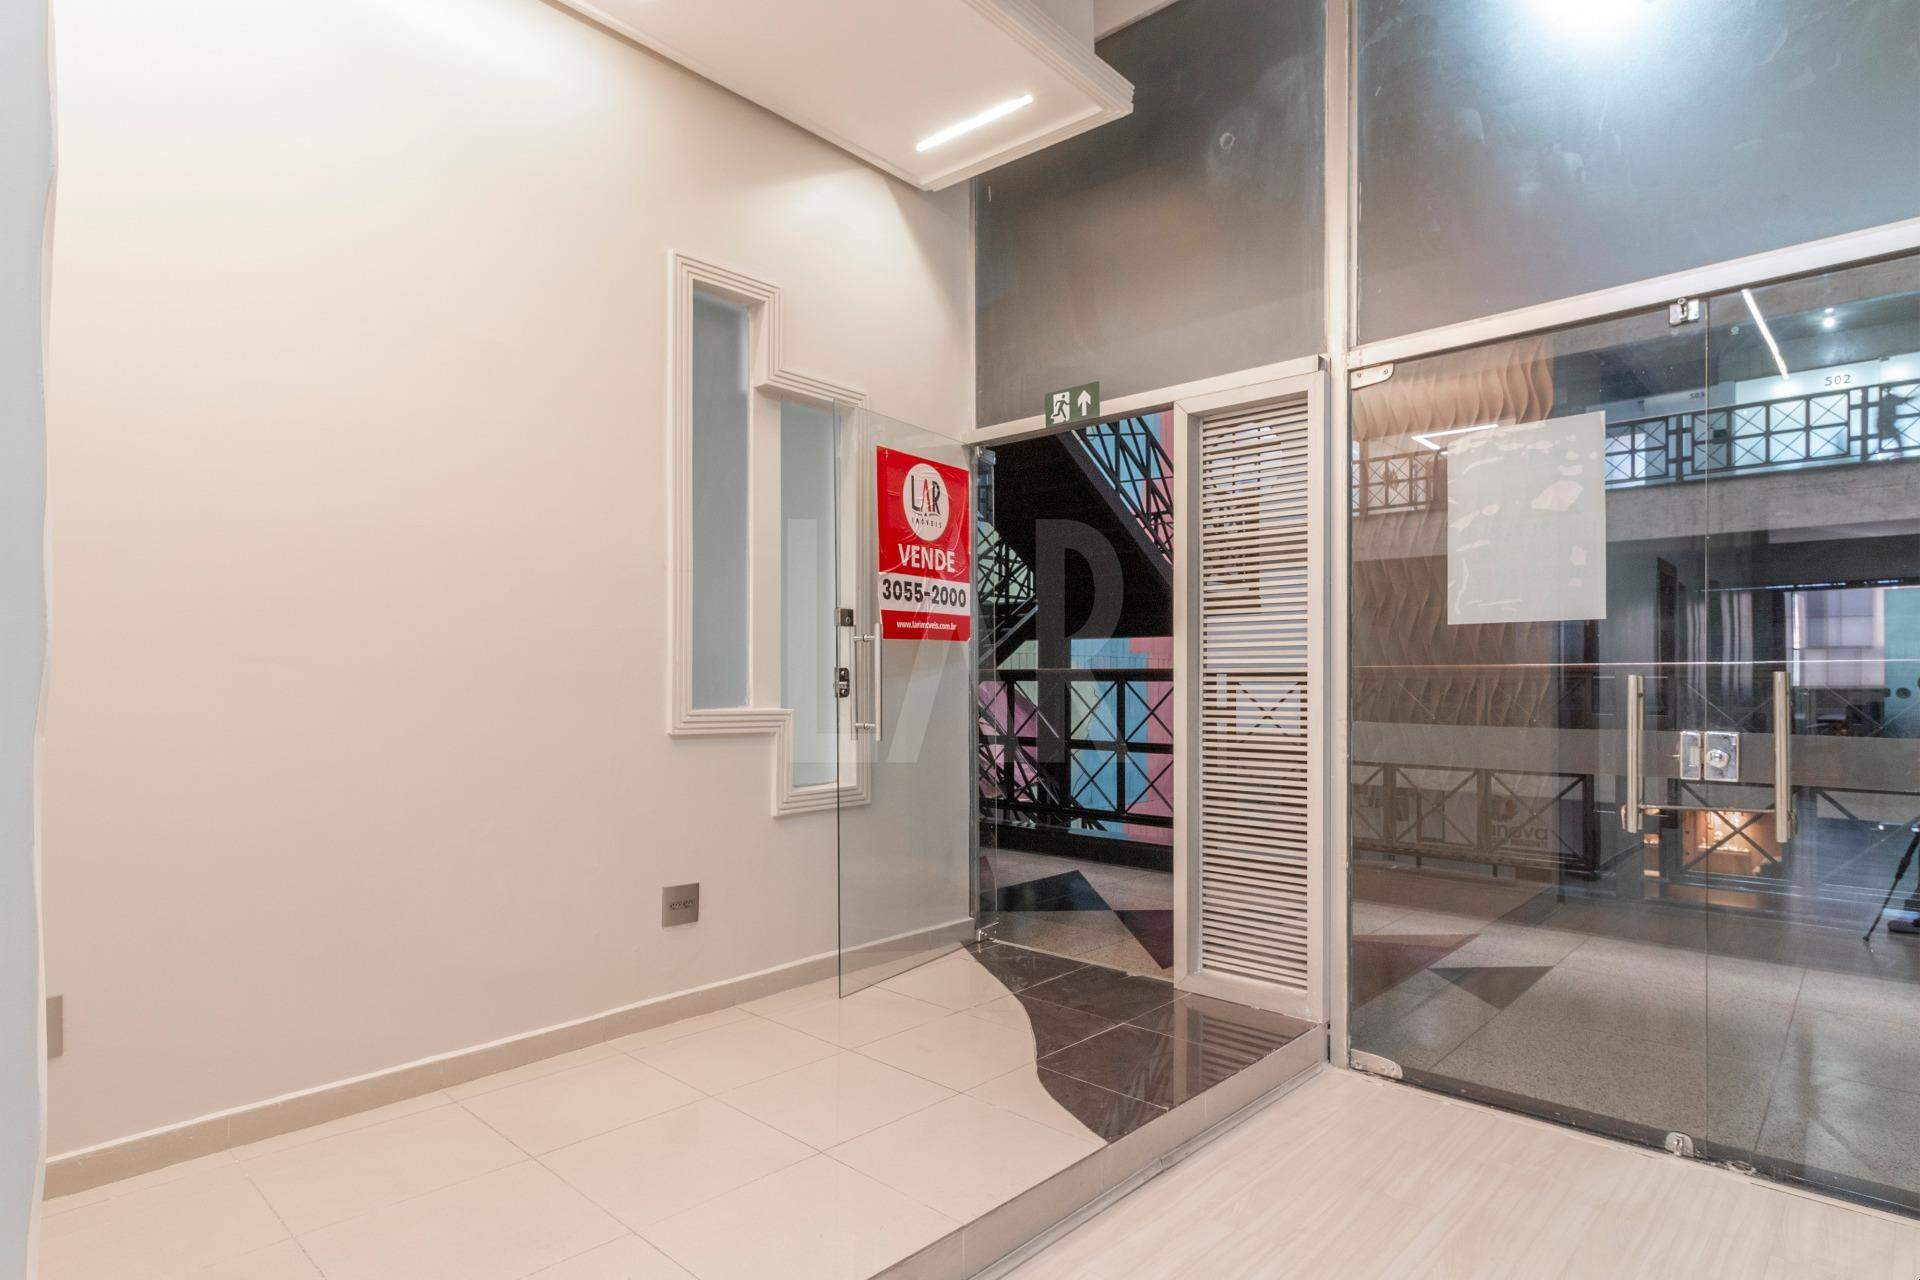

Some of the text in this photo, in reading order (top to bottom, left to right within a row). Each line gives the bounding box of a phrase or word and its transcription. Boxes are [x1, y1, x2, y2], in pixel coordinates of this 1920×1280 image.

[1824, 374, 1852, 386] 502
[911, 475, 941, 515] LAR
[898, 543, 956, 573] VENDE
[882, 578, 967, 607] 3055-2000
